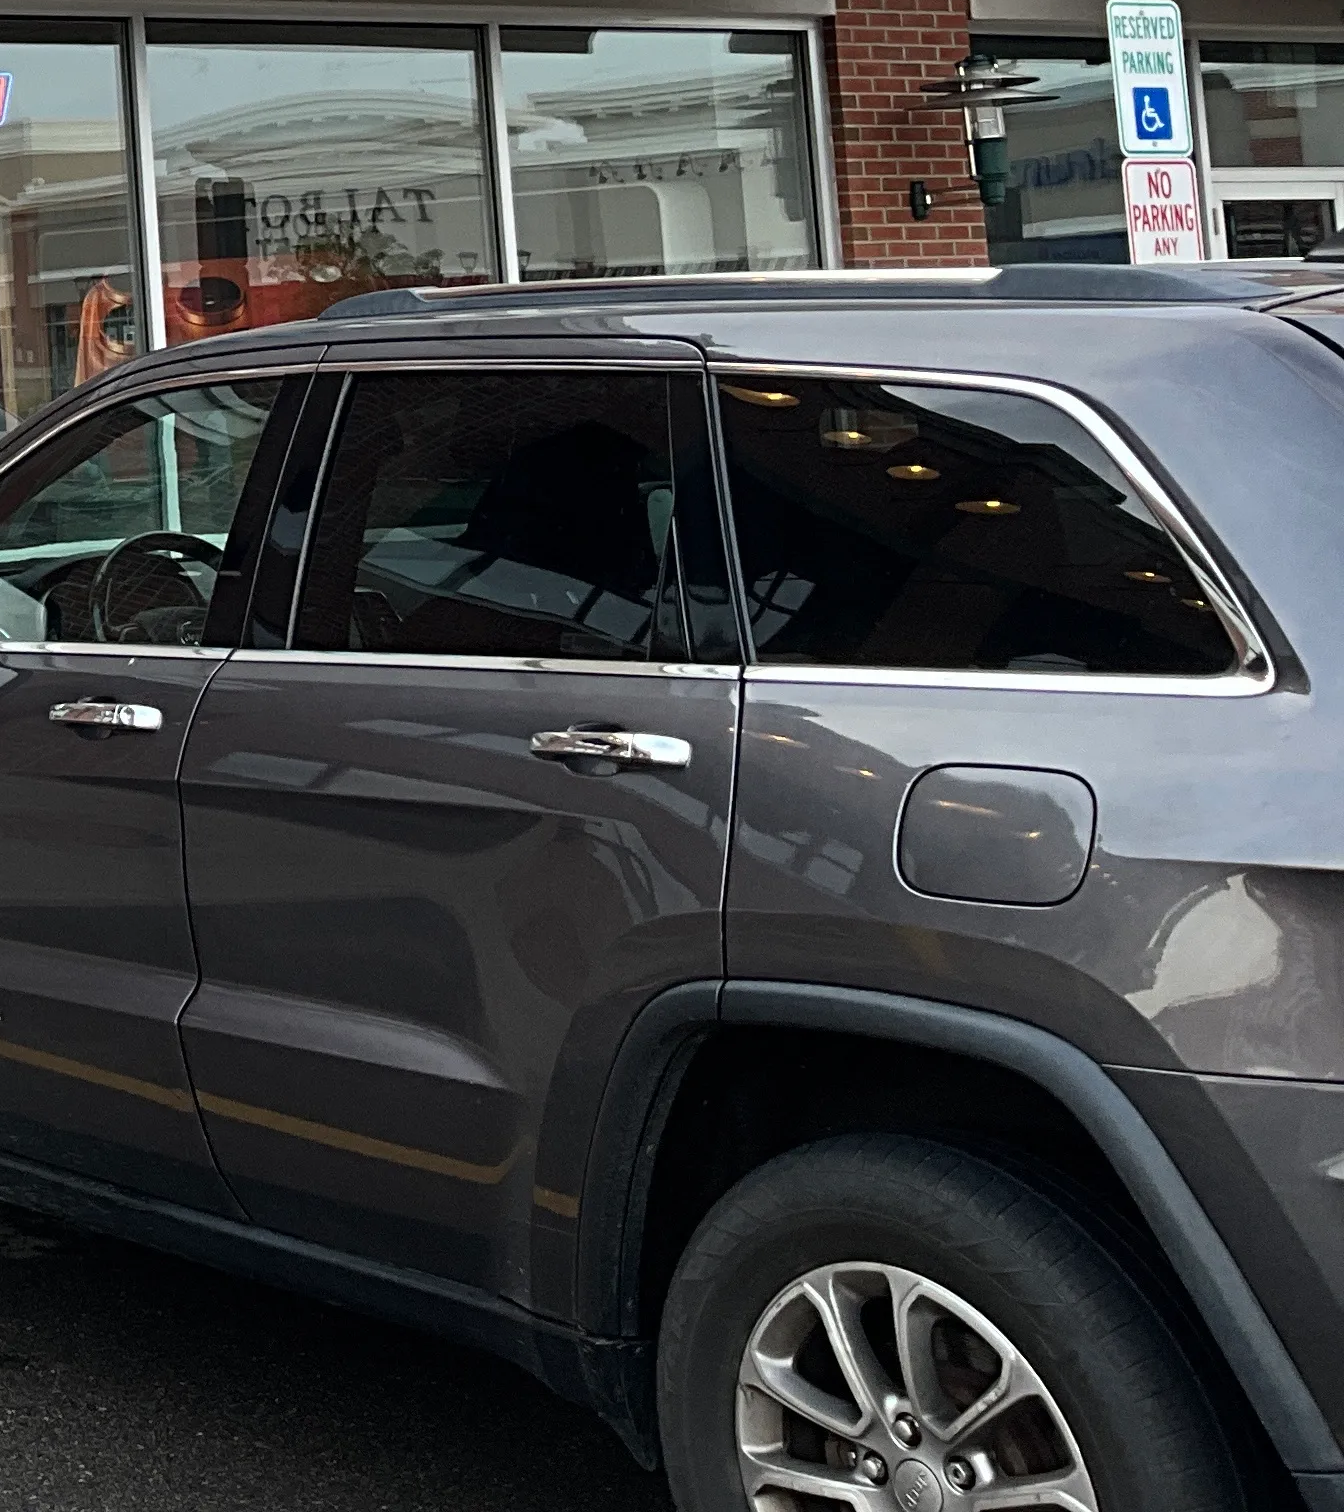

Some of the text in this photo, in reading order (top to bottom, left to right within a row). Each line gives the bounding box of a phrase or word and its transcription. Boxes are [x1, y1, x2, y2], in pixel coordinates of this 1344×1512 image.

[1113, 15, 1176, 41] RESERVED
[1121, 50, 1175, 75] PARKING
[1146, 170, 1173, 200] NO
[1132, 203, 1195, 232] PARKING
[1153, 236, 1179, 257] ANY
